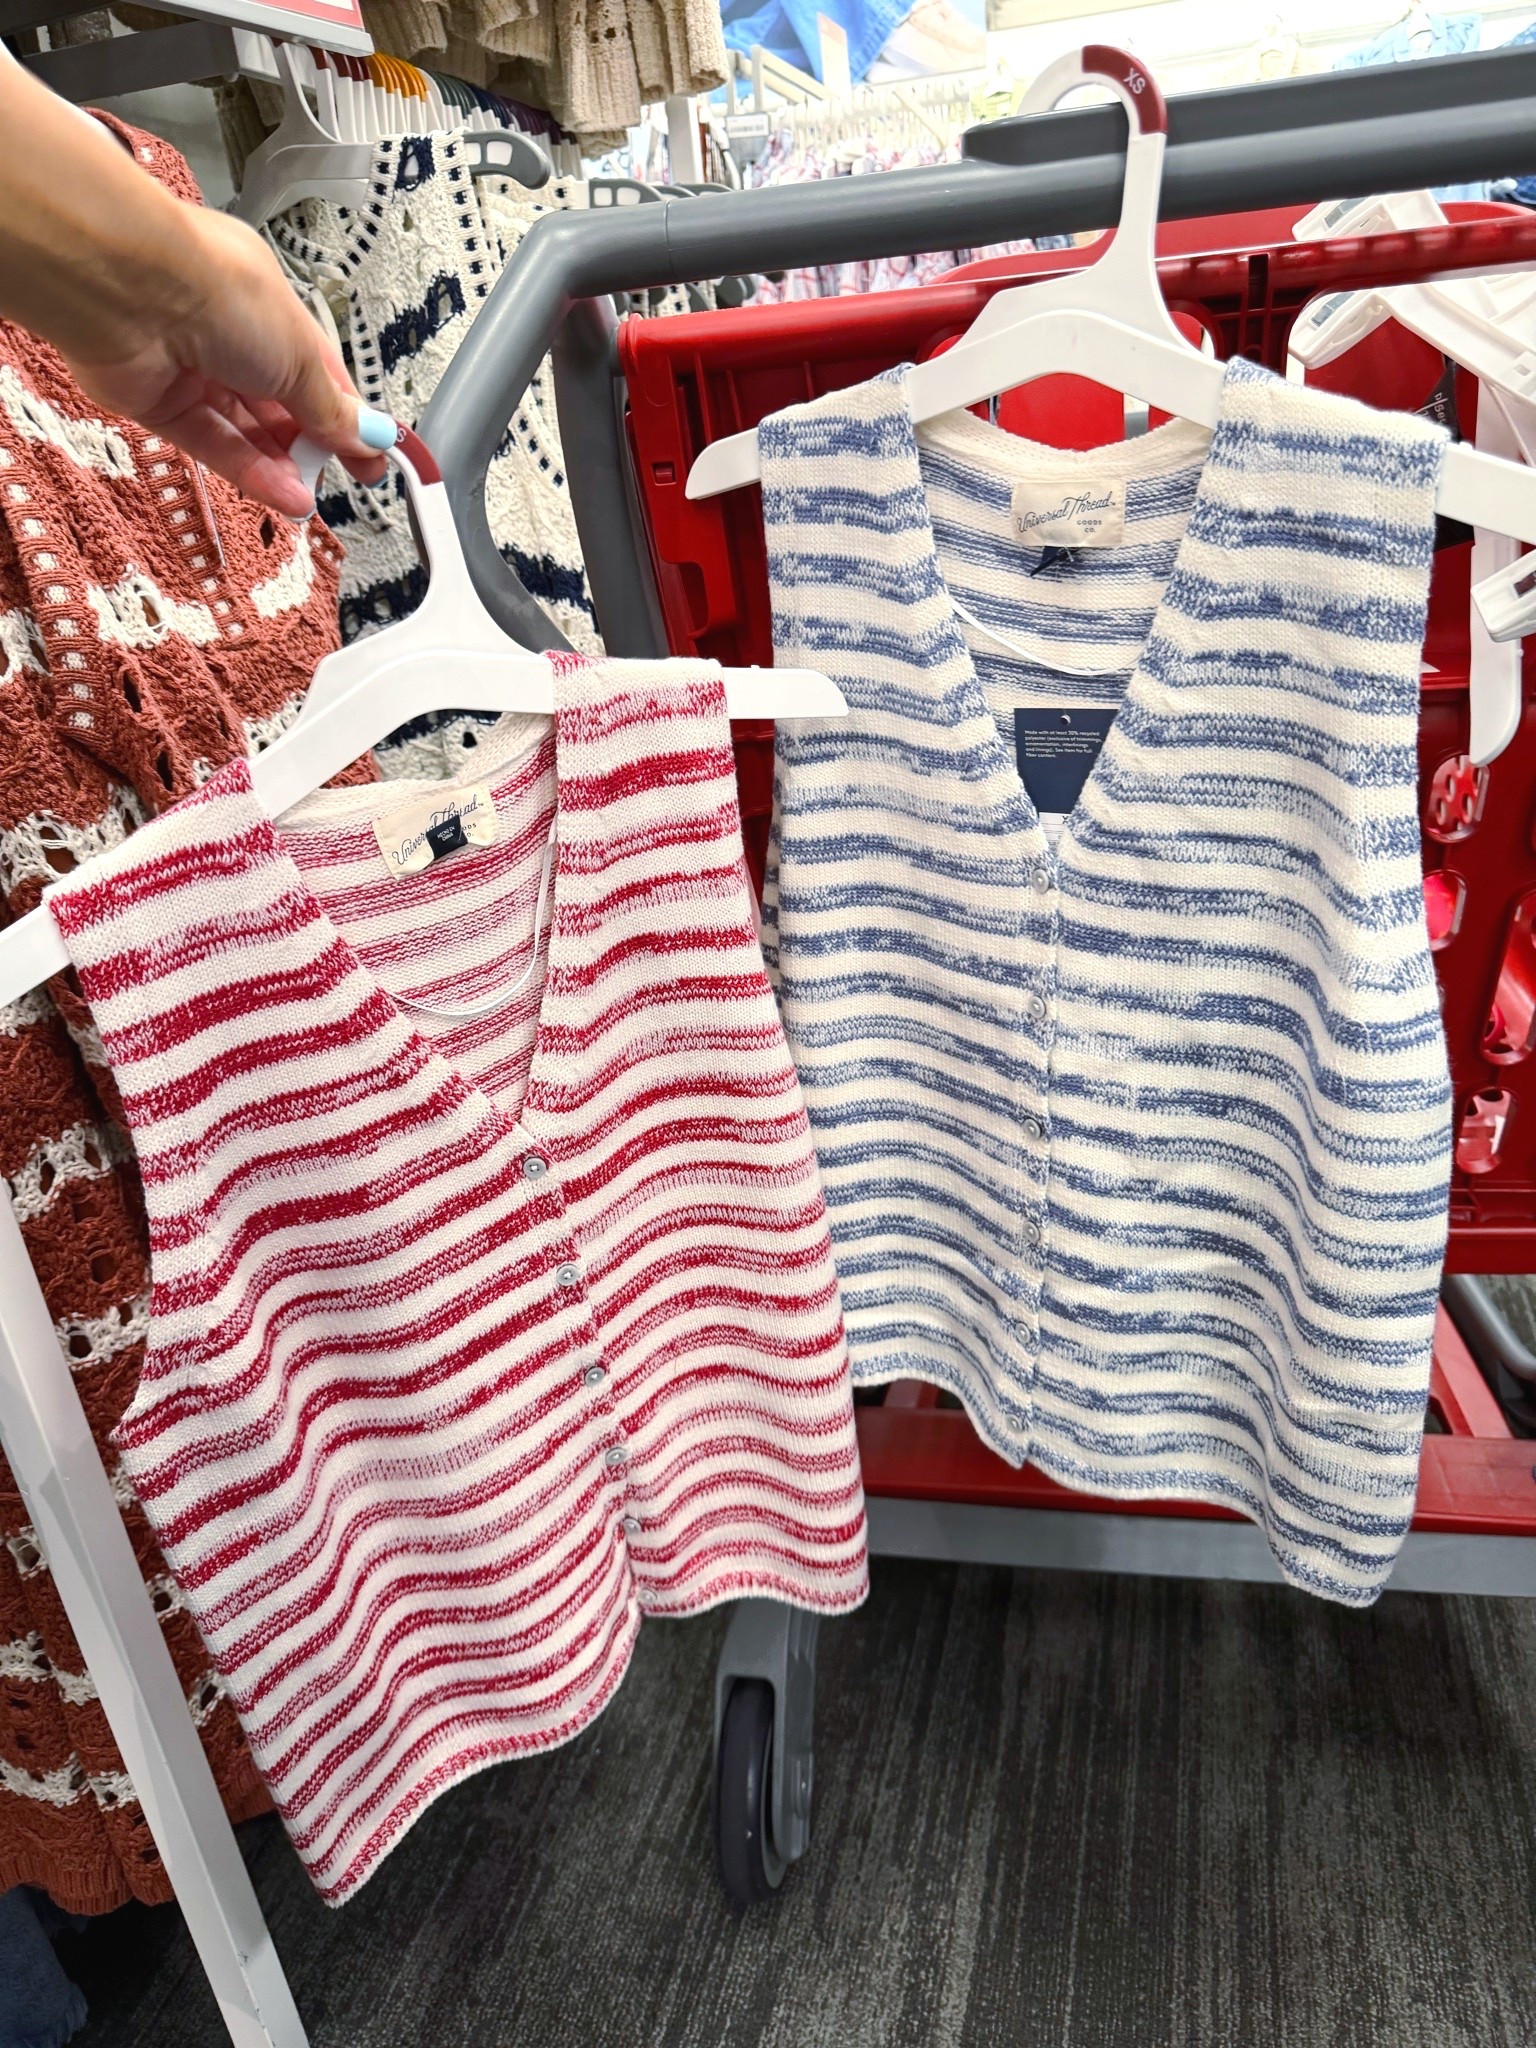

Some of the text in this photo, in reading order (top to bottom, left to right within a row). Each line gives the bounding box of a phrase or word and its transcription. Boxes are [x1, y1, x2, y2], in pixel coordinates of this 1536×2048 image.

[1123, 67, 1146, 94] XS
[1017, 490, 1111, 533] Universal Thread
[391, 815, 437, 866] Univerl
